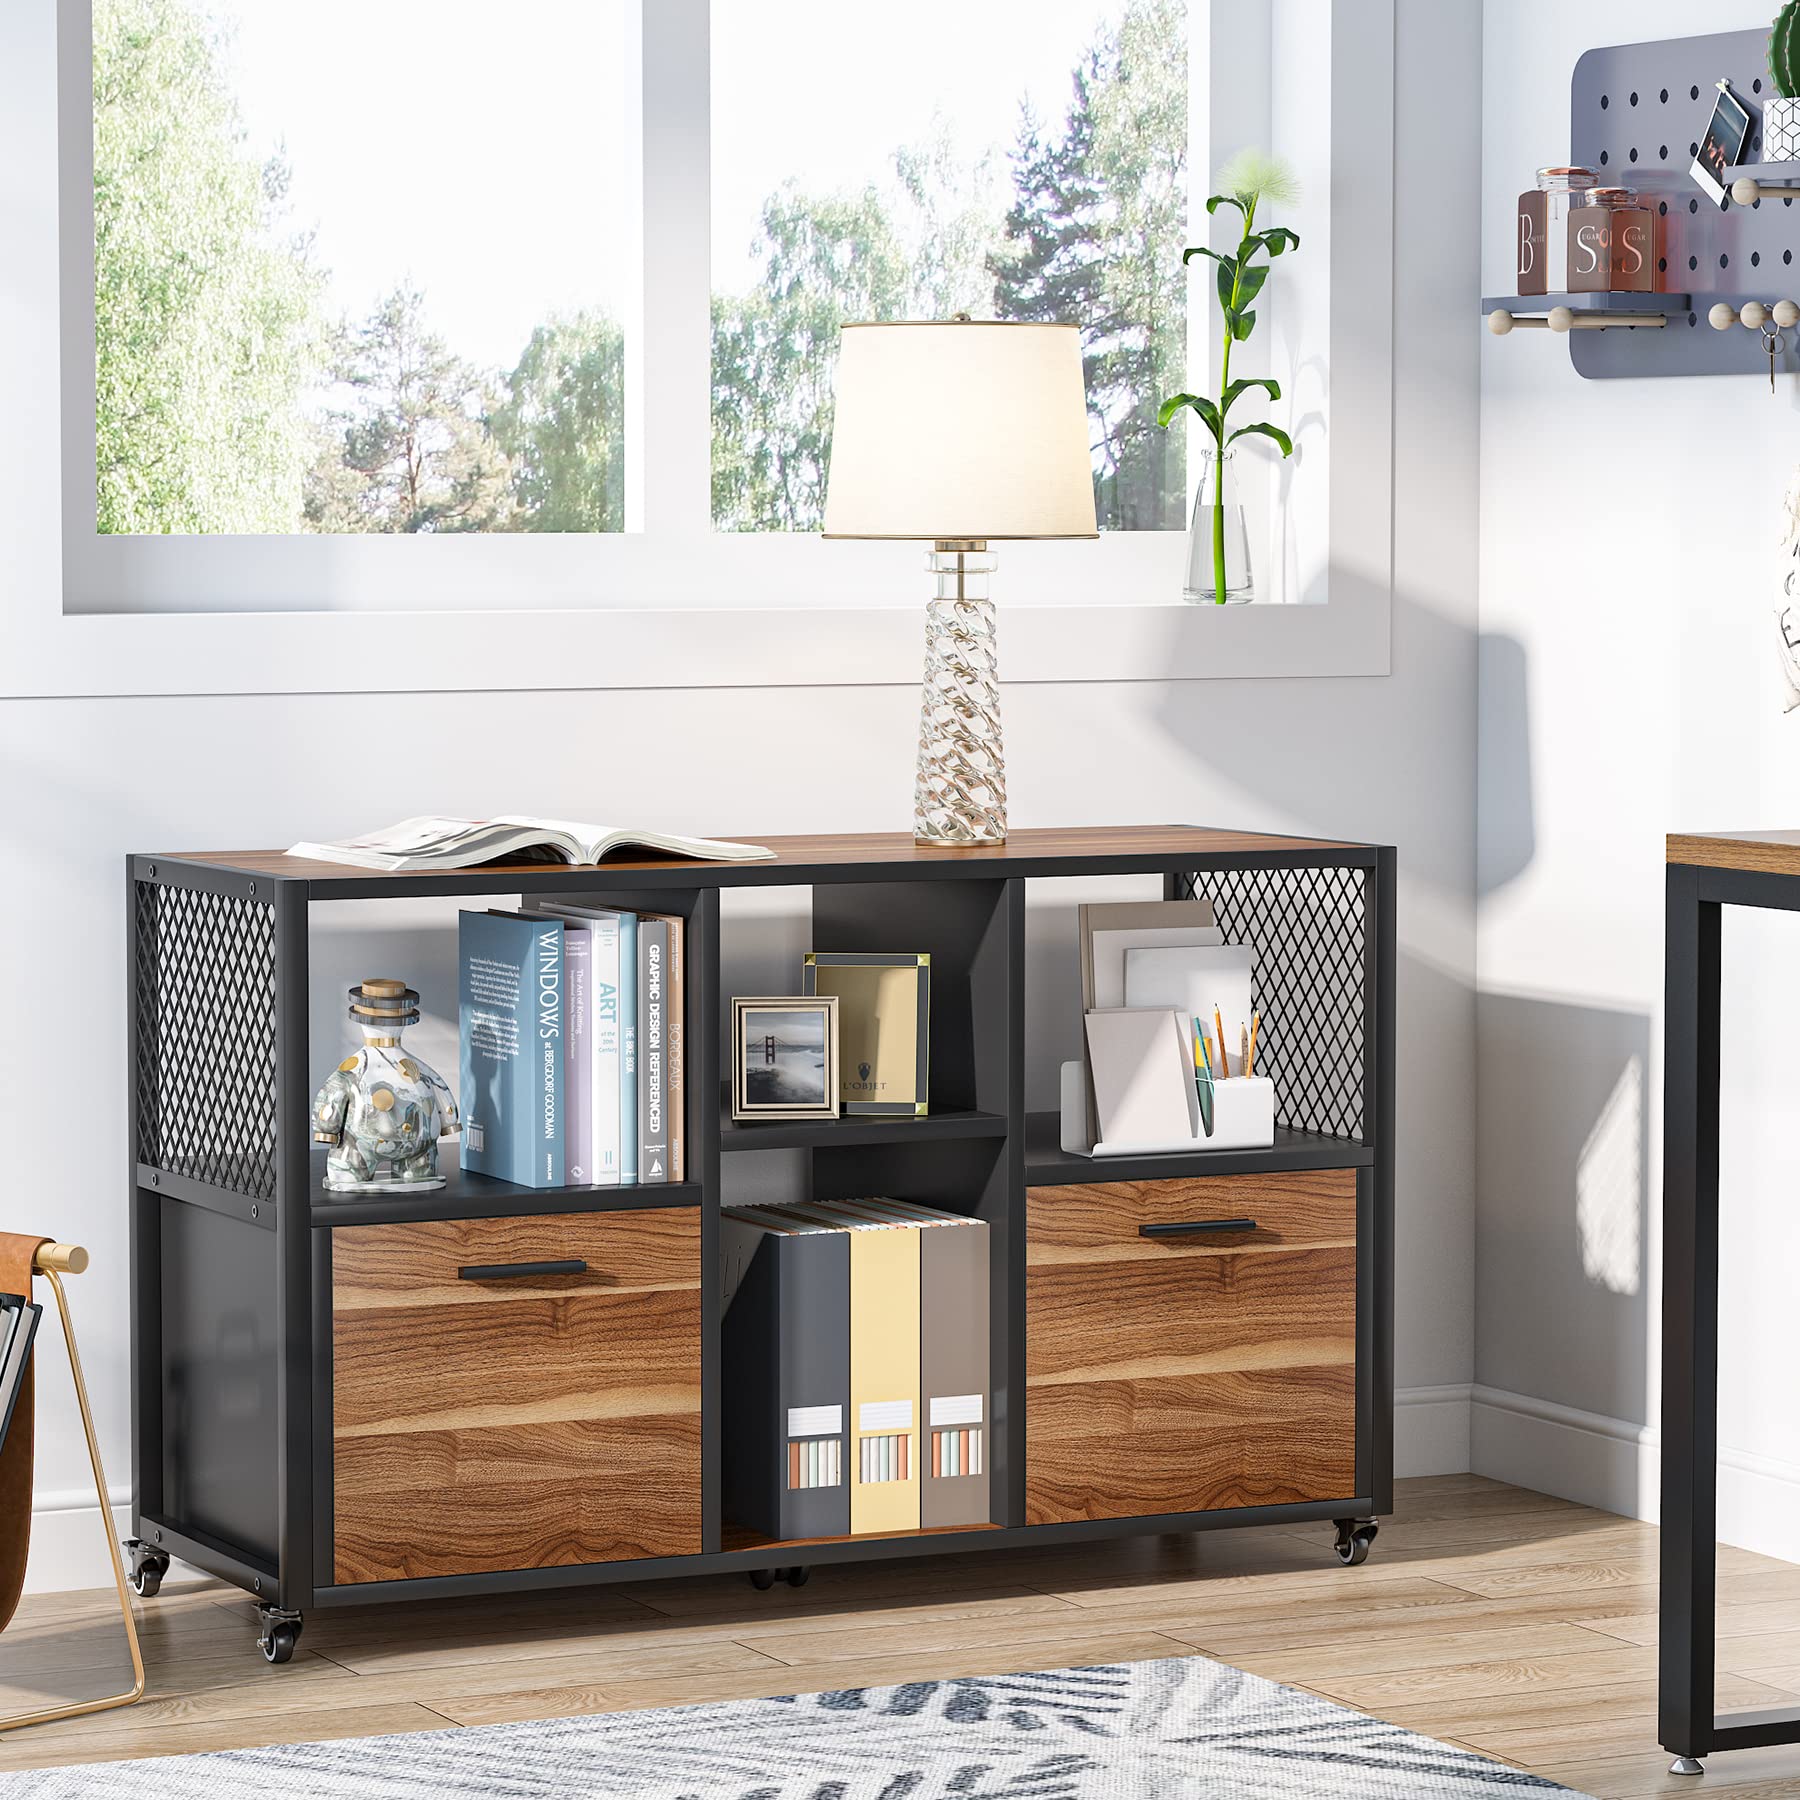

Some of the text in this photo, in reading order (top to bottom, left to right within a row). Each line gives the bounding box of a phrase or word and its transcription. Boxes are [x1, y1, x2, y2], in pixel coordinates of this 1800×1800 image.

[539, 929, 559, 1039] WINDOWS
[576, 969, 584, 982] The
[576, 984, 584, 996] Art
[649, 944, 660, 1000] GRAPHIC
[574, 1006, 584, 1034] Knitting
[599, 983, 617, 1023] ART
[625, 1026, 635, 1039] THE
[649, 1003, 660, 1048] DESIGN
[544, 1050, 554, 1093] BERGDORF
[669, 1023, 680, 1090] BORDEAUX
[649, 1052, 660, 1133] REFERENCED
[843, 1081, 888, 1091] L'OBJET
[544, 1094, 554, 1139] GOODMAN
